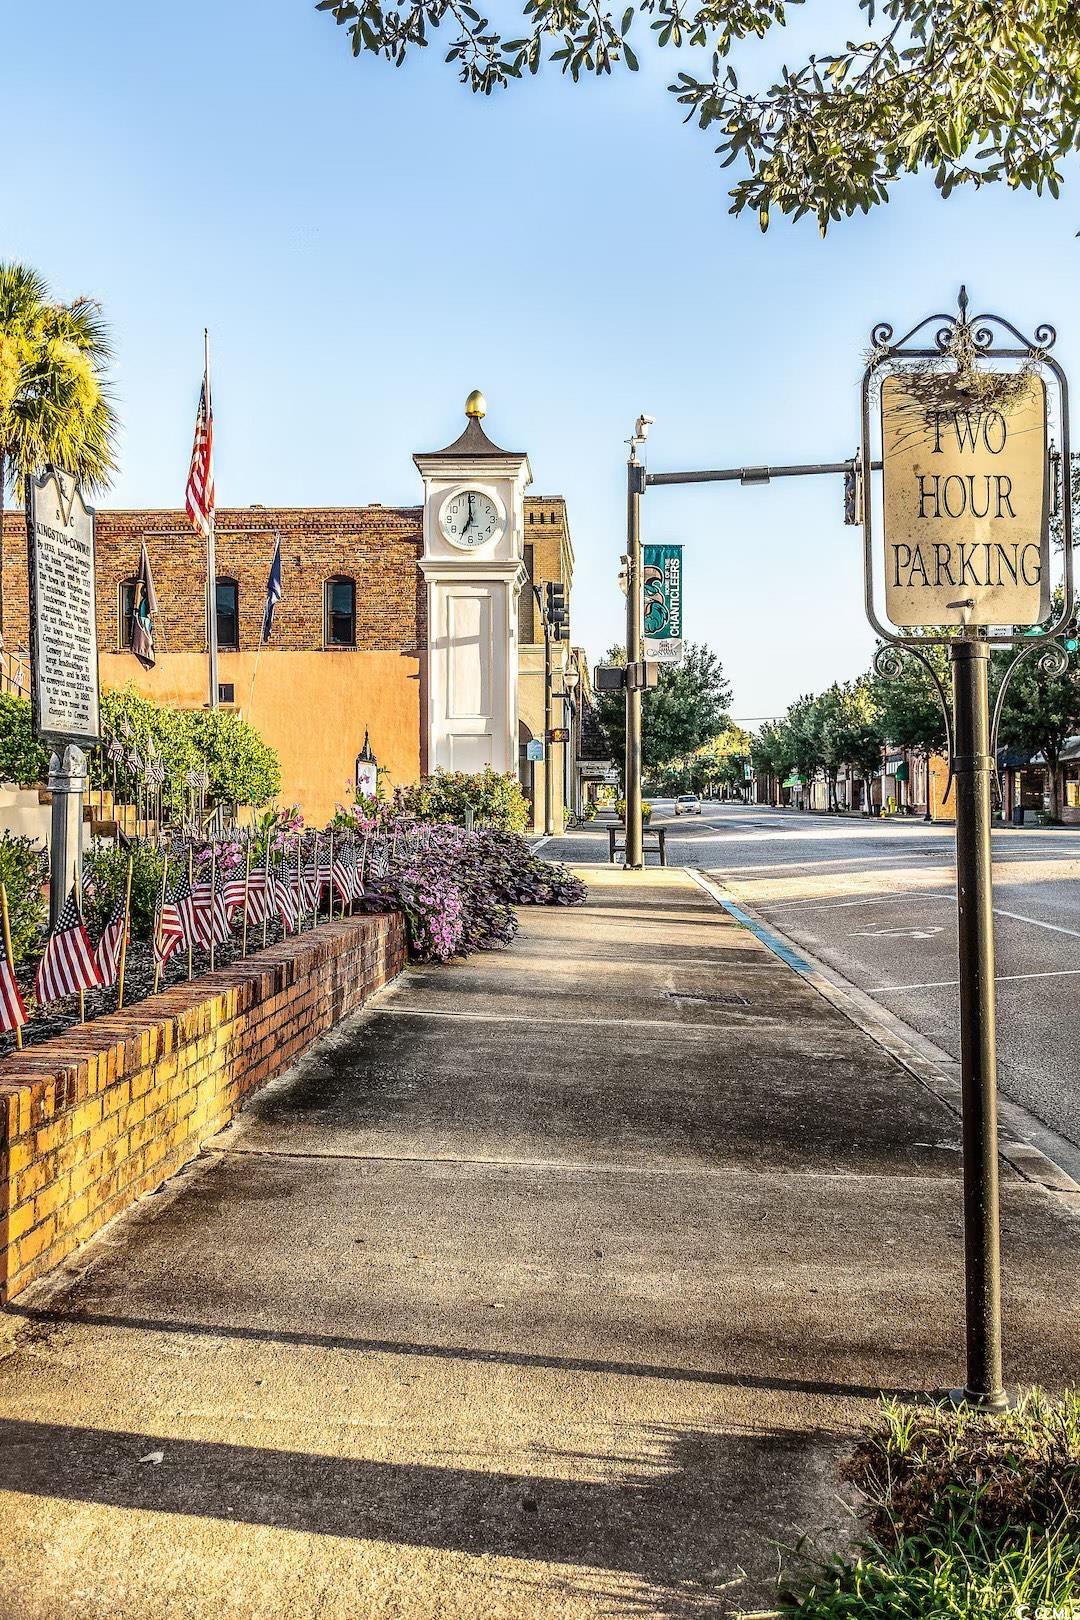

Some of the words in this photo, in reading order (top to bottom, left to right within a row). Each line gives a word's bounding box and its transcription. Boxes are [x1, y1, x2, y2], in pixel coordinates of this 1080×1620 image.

[926, 411, 1006, 454] TWO
[486, 506, 491, 514] 2
[915, 475, 1016, 518] HOUR
[56, 510, 60, 520] S
[70, 516, 74, 527] C
[890, 543, 1042, 587] PARKING
[670, 558, 680, 636] CHANTICLEERS
[646, 648, 678, 658] CONWAY
